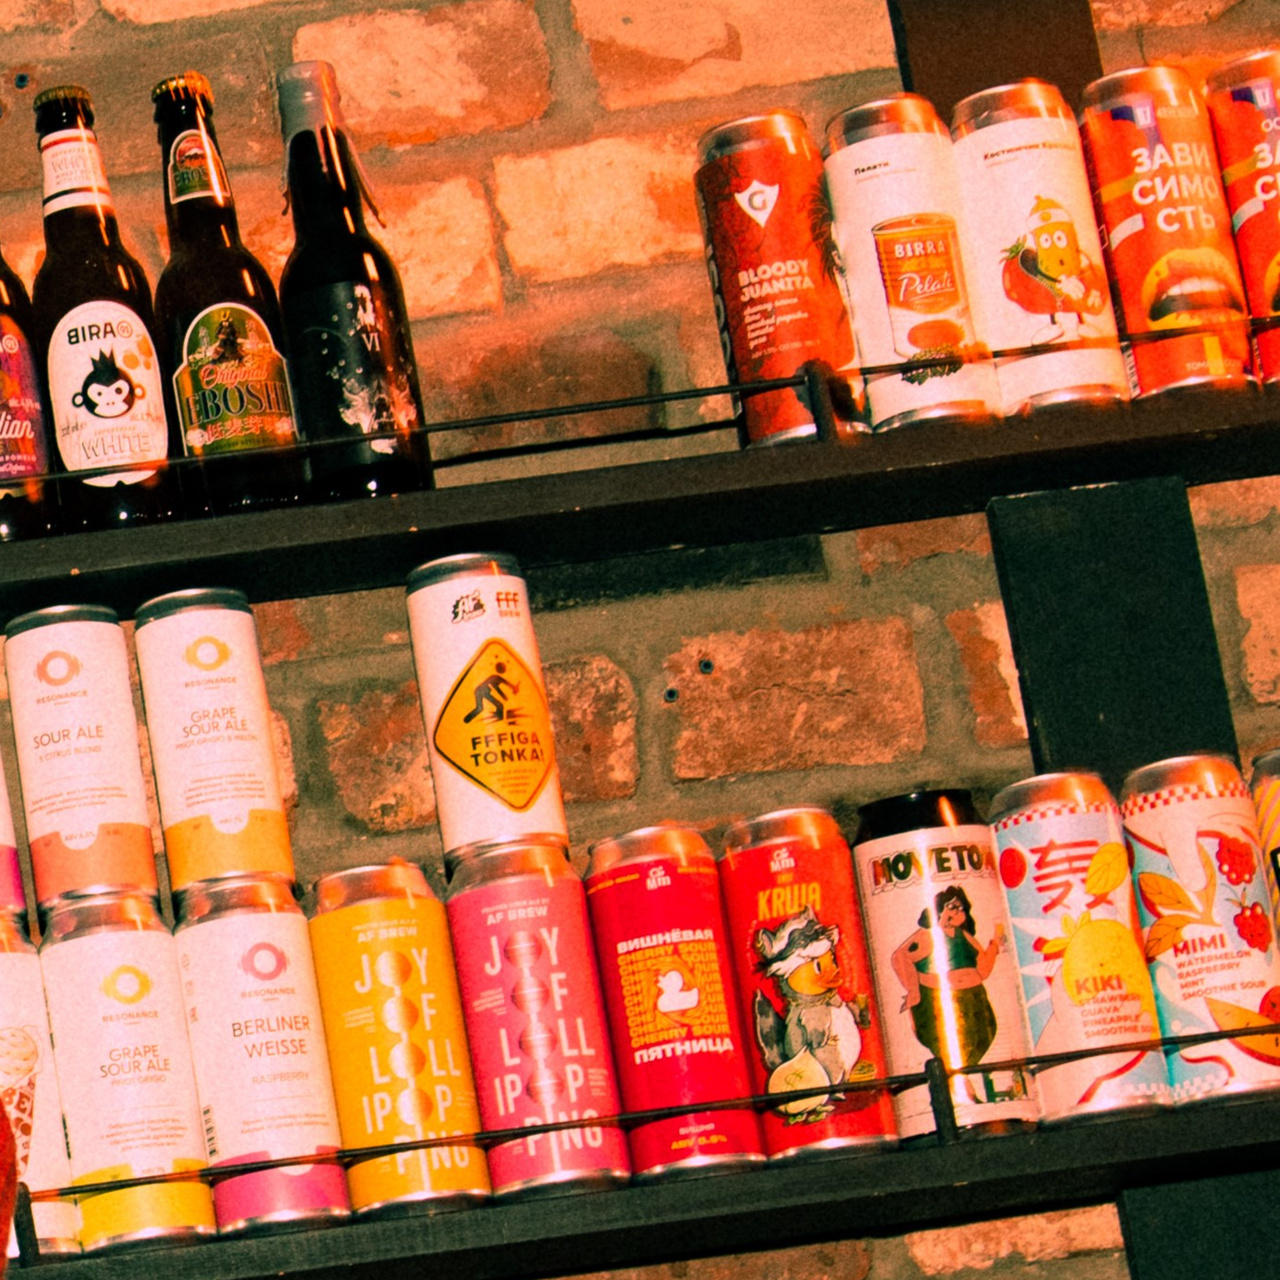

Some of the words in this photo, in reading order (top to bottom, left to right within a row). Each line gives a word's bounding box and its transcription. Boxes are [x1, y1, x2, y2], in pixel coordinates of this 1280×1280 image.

[1131, 142, 1211, 173] ЗАВИ
[1132, 174, 1219, 205] СИМО
[1157, 205, 1216, 233] СТЬ
[894, 238, 946, 259] BIRRA
[738, 259, 809, 288] BLOODY
[740, 275, 815, 302] JUANITA
[898, 272, 954, 302] Pelati
[67, 322, 117, 345] BIRA
[199, 363, 268, 389] Original
[186, 381, 290, 426] EBOSHI
[81, 433, 153, 460] WHITE
[185, 676, 238, 689] RESONANCE
[36, 690, 89, 705] RESONANCE
[190, 706, 237, 724] GRAPE
[33, 728, 71, 750] SOUR
[76, 724, 105, 740] ALE
[183, 721, 221, 739] SOUR
[225, 719, 250, 732] ALE
[471, 731, 541, 751] FFFIGA
[486, 914, 504, 926] AF
[508, 905, 548, 921] BREW
[357, 932, 376, 944] AF
[379, 926, 418, 940] BREW
[616, 928, 714, 955] ВИШНЁВАЯ
[1173, 933, 1227, 958] MIMI
[617, 944, 674, 966] CHERRY
[678, 940, 717, 953] SOUR
[1176, 949, 1251, 969] WATERMELON
[1178, 961, 1241, 980] RASPBERRY
[240, 987, 296, 999] RESONANCE
[1075, 973, 1124, 995] KIKI
[1180, 977, 1206, 991] MINT
[1182, 983, 1237, 1002] SMOOTHIE
[1239, 979, 1267, 990] SOUR
[102, 1010, 160, 1023] RESONANCE
[1080, 1005, 1120, 1018] GUAVA
[1082, 1014, 1141, 1029] PINEAPPLE
[231, 1015, 311, 1038] BERLINER
[630, 1026, 689, 1049] CHERRY
[691, 1023, 731, 1037] SOUR
[1084, 1025, 1139, 1039] SMOOTHIE
[109, 1044, 161, 1062] GRAPE
[243, 1038, 308, 1059] WEISSE
[634, 1037, 735, 1065] ПЯТНИЦА
[100, 1060, 142, 1078] SOUR
[147, 1058, 172, 1072] ALE
[252, 1071, 310, 1084] RASPBERRY
